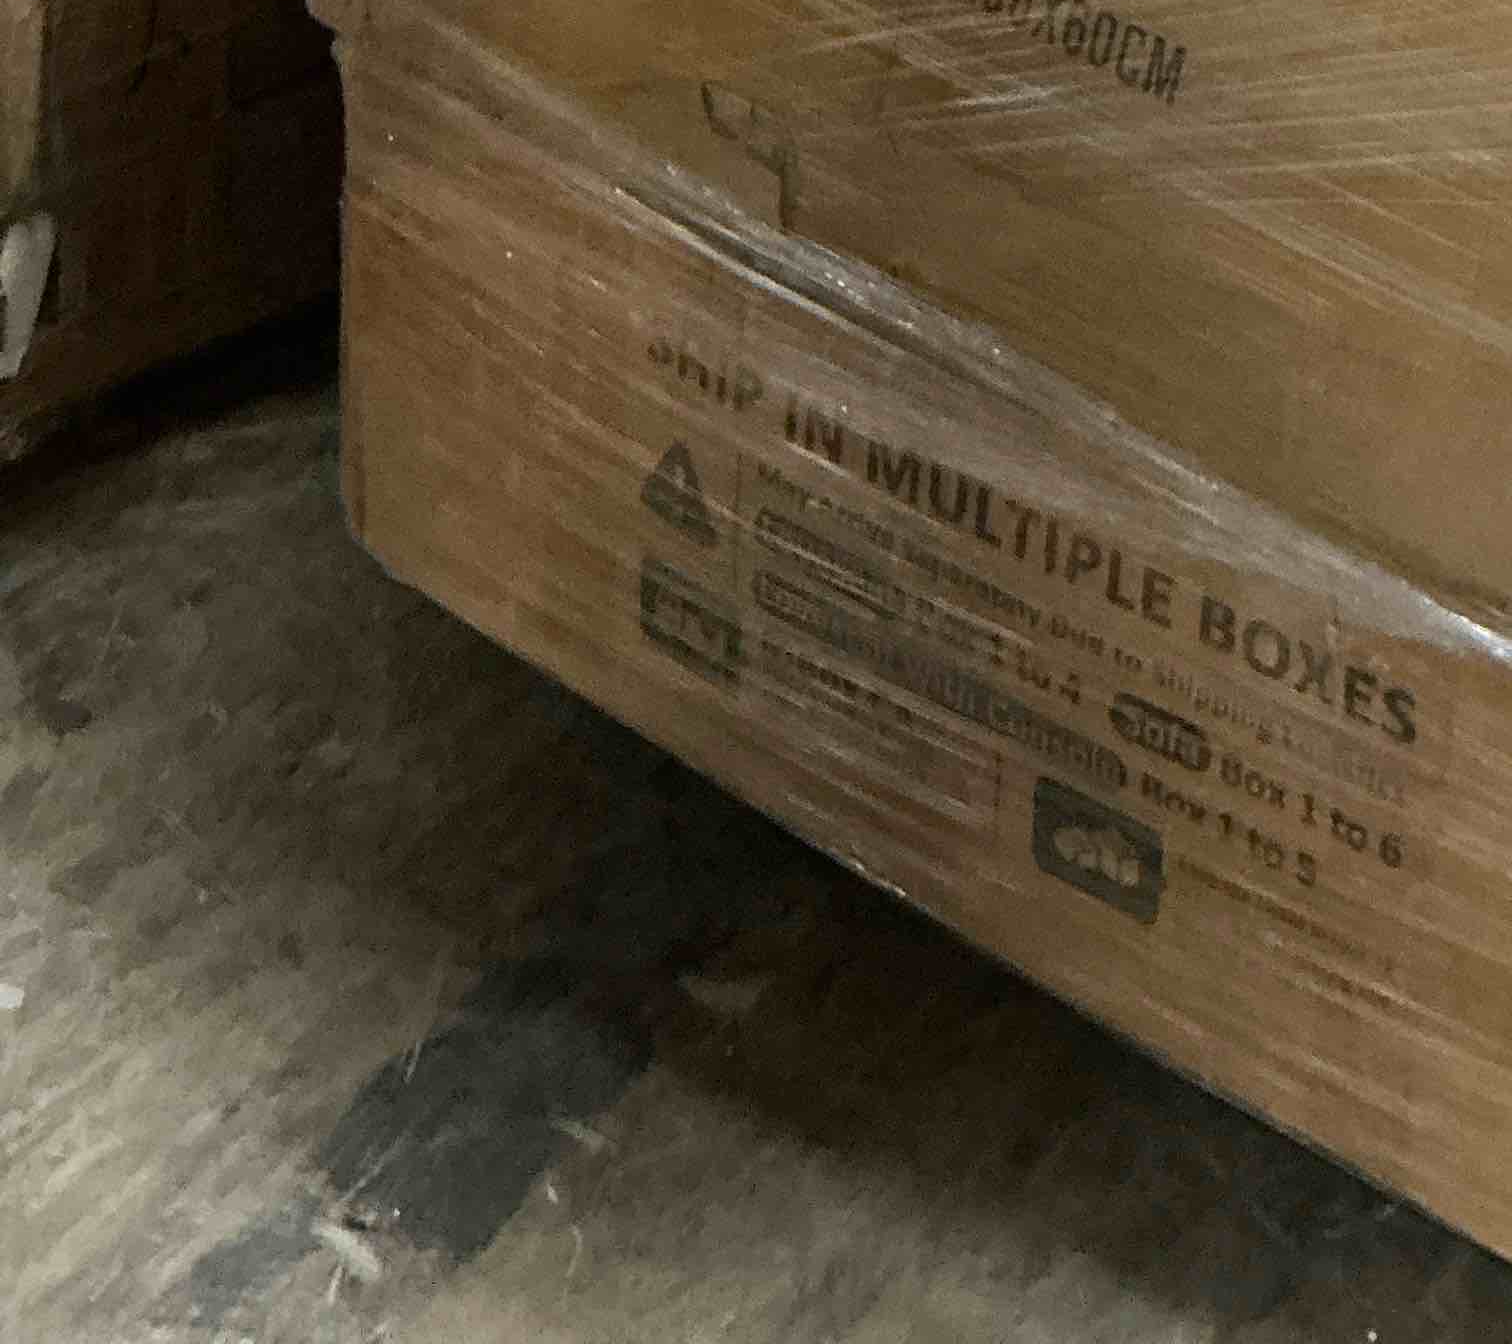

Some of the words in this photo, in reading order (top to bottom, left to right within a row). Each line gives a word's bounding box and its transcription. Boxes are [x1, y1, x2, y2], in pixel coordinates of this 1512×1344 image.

[784, 394, 845, 464] IN
[866, 439, 1177, 630] MULTIPLE
[1199, 594, 1418, 744] BOXES
[1329, 805, 1369, 853] to
